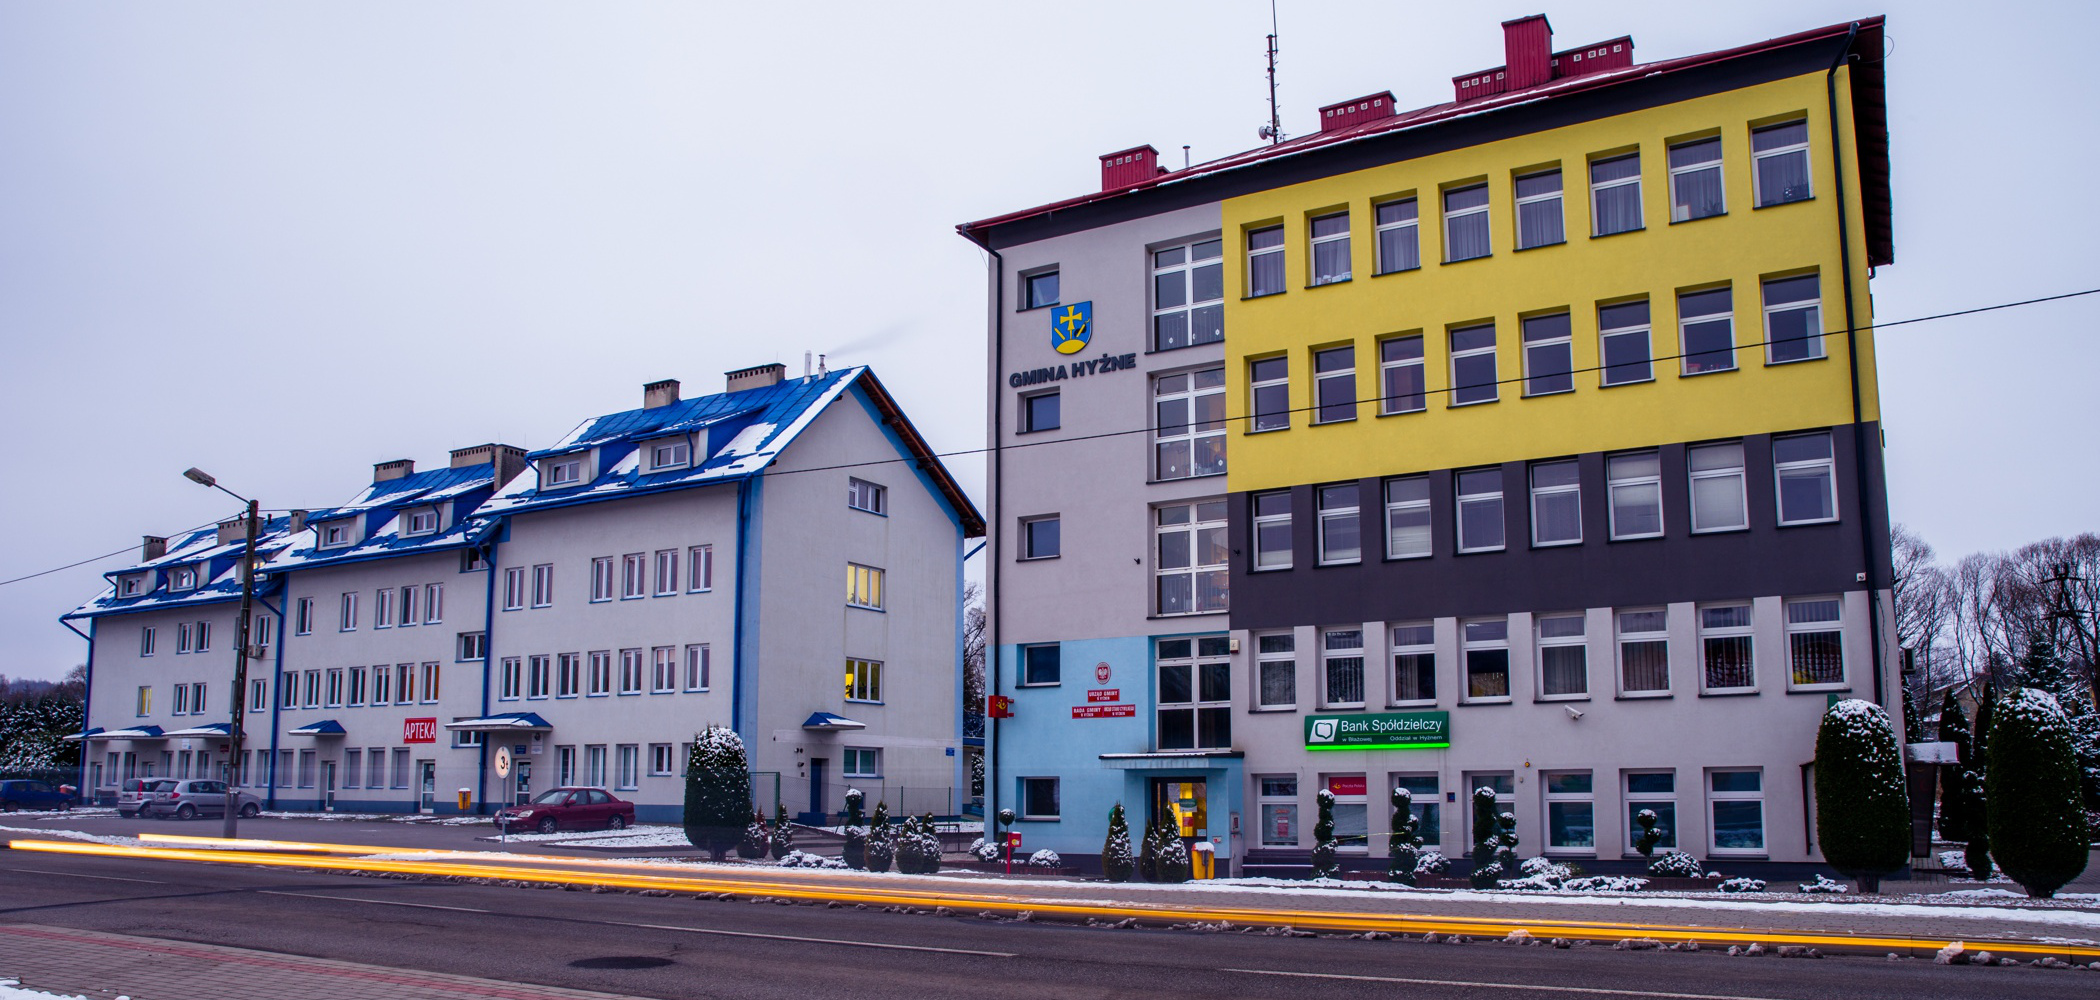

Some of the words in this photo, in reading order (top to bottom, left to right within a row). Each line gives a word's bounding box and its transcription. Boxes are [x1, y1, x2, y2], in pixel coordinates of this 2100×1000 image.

[1009, 365, 1068, 388] GMINA
[1071, 353, 1136, 378] HYŻNE
[404, 722, 436, 739] APTEKA
[1341, 720, 1369, 732] Bank
[1372, 718, 1442, 733] Spółdzielczy
